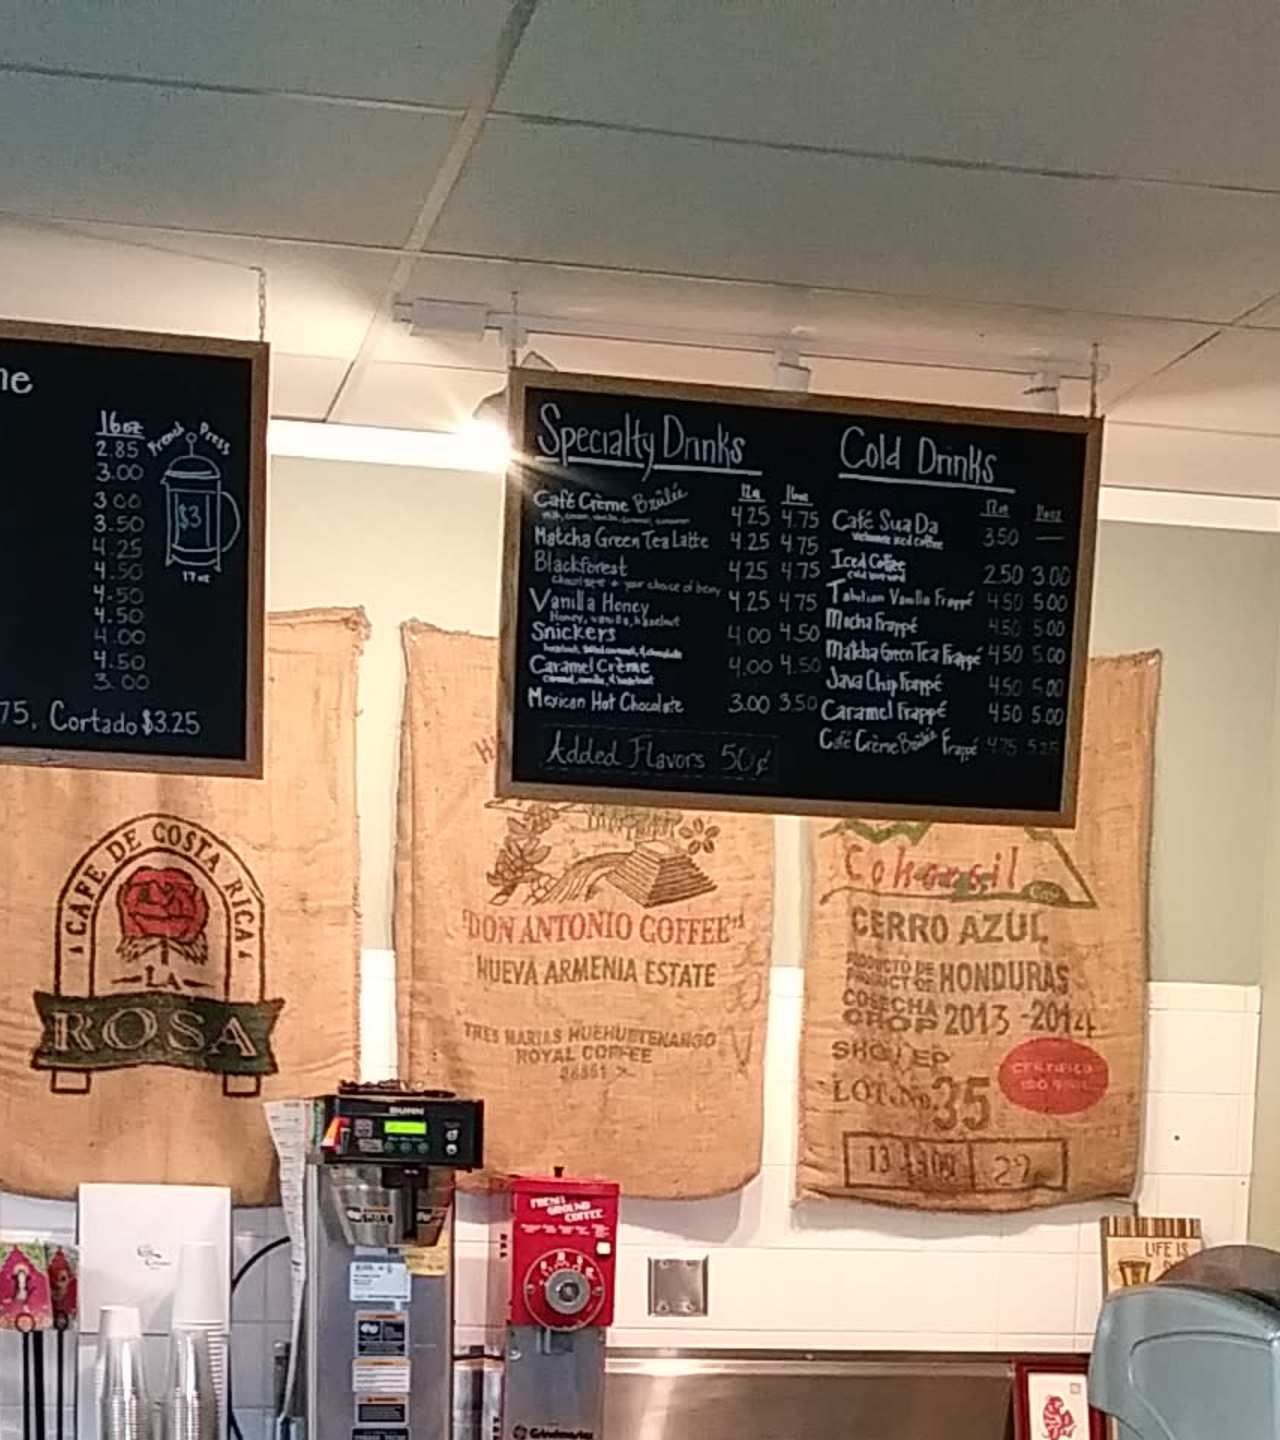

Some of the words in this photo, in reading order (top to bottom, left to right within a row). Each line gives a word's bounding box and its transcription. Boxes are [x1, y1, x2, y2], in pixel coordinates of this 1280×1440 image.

[199, 421, 230, 456] Press
[537, 402, 655, 481] Specialty
[663, 414, 746, 470] Drinks
[840, 426, 901, 470] Cold
[918, 437, 997, 484] Drinks
[533, 490, 574, 509] Café
[579, 492, 629, 513] Crème
[832, 509, 872, 531] Café
[880, 509, 912, 532] Sua
[915, 513, 938, 534] Da
[534, 527, 590, 547] Matcha
[594, 530, 640, 549] Green
[642, 530, 669, 549] Tea
[534, 550, 628, 576] Blackforest
[830, 550, 866, 569] Iced
[870, 552, 906, 571] Coffee
[529, 587, 596, 613] Vanilla
[603, 591, 650, 615] Honey
[531, 622, 616, 643] Snickers
[825, 608, 872, 630] Mocha
[529, 655, 593, 675] Caramel
[596, 658, 650, 674] Crème
[825, 639, 878, 662] Matcha
[880, 642, 914, 663] Green
[910, 641, 940, 663] Tea
[825, 665, 863, 690] Java
[866, 669, 898, 697] Chip
[528, 687, 585, 710] Mexican
[592, 691, 617, 712] Hot
[620, 691, 684, 713] Chocolate
[821, 699, 892, 721] Caramel
[897, 700, 948, 725] Frappé
[50, 700, 137, 735] Cortado
[142, 709, 200, 736] $3.25
[546, 730, 620, 767] Added
[629, 735, 705, 769] Flavors
[65, 864, 108, 939] CAFE
[110, 828, 142, 864] DE
[151, 821, 220, 875] COSTA
[223, 877, 256, 944] RICA
[521, 910, 633, 945] ANTONIO
[851, 906, 949, 945] CERRO
[959, 910, 1049, 945] AZUL
[144, 966, 182, 990] LA
[544, 955, 638, 985] ARMENIA
[645, 960, 717, 988] ESTATE
[939, 959, 1070, 994] HONDURAS
[52, 1005, 257, 1058] ROSA
[944, 1002, 1010, 1037] 2013
[931, 1076, 991, 1131] 35
[1145, 1242, 1172, 1257] LIFE
[1177, 1242, 1188, 1257] IS
